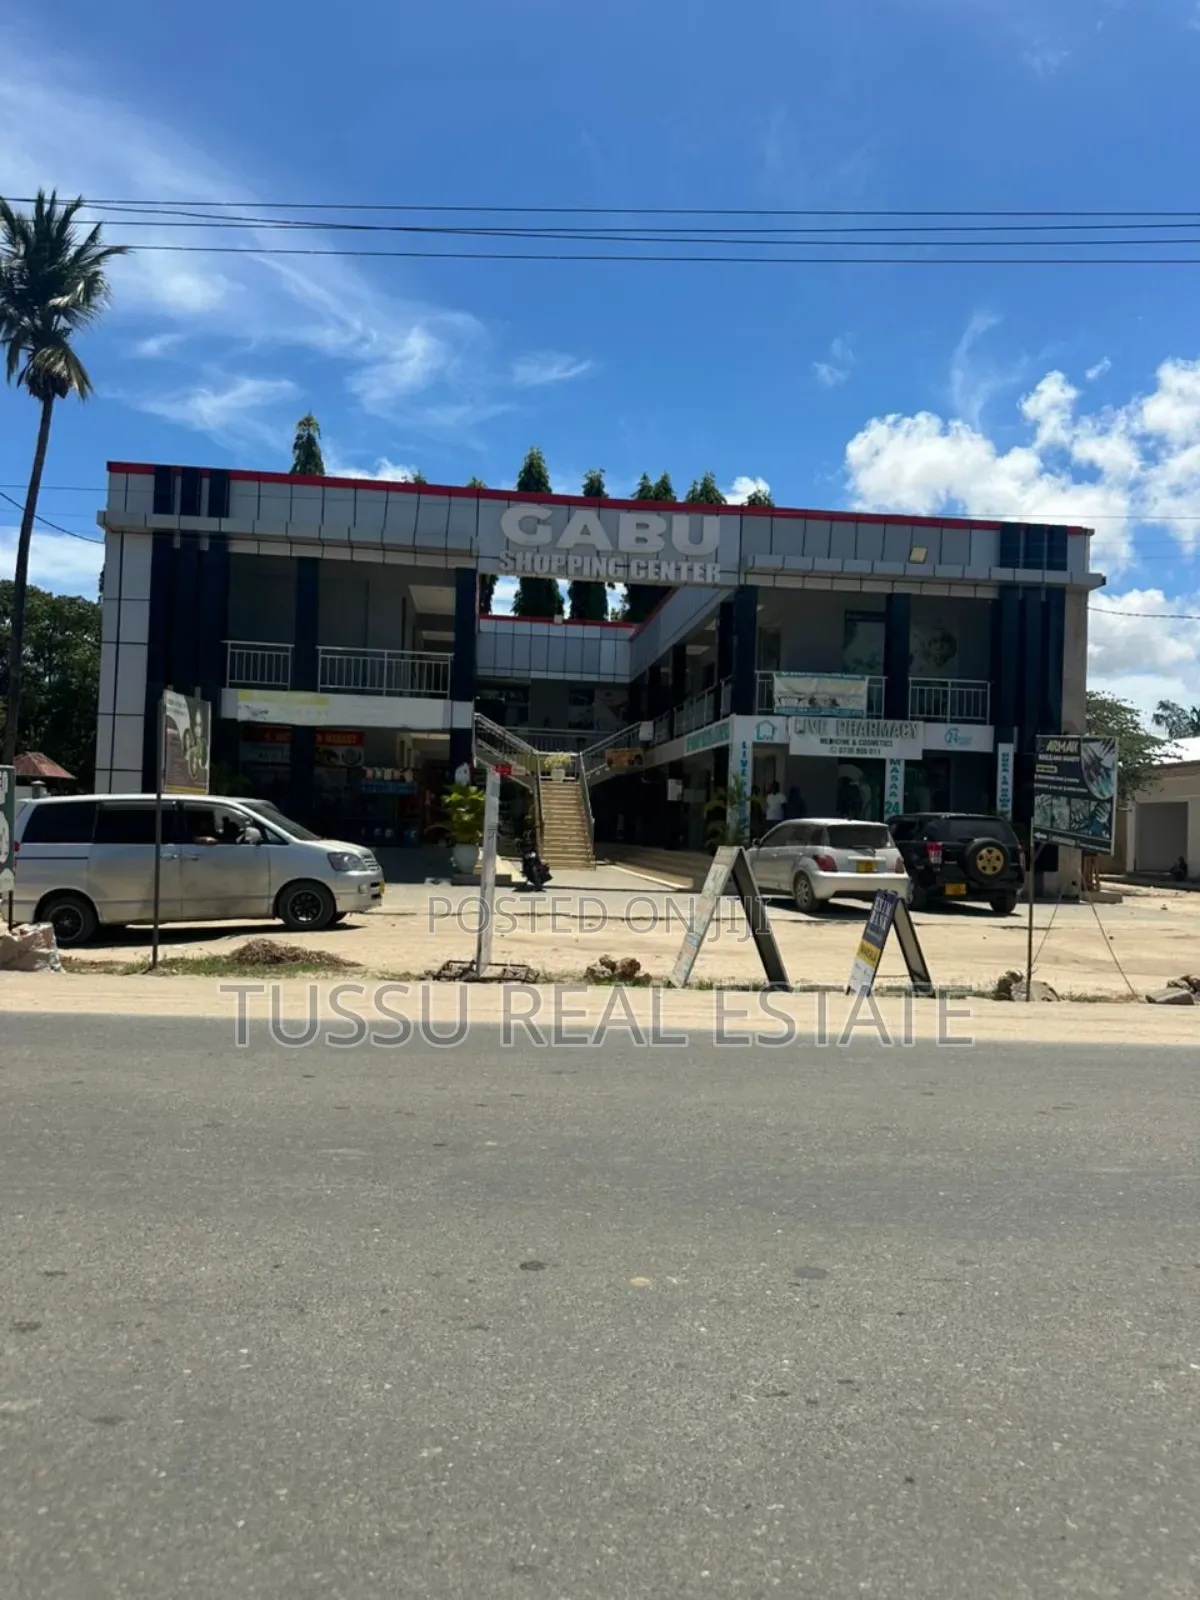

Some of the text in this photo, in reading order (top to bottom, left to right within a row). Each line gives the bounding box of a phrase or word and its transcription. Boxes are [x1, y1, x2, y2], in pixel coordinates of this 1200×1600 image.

[501, 504, 720, 556] GABU
[500, 550, 720, 583] SHOPPING CENTER
[836, 718, 918, 739] PHARMACY
[890, 759, 901, 798] MASAA
[886, 800, 900, 814] 24
